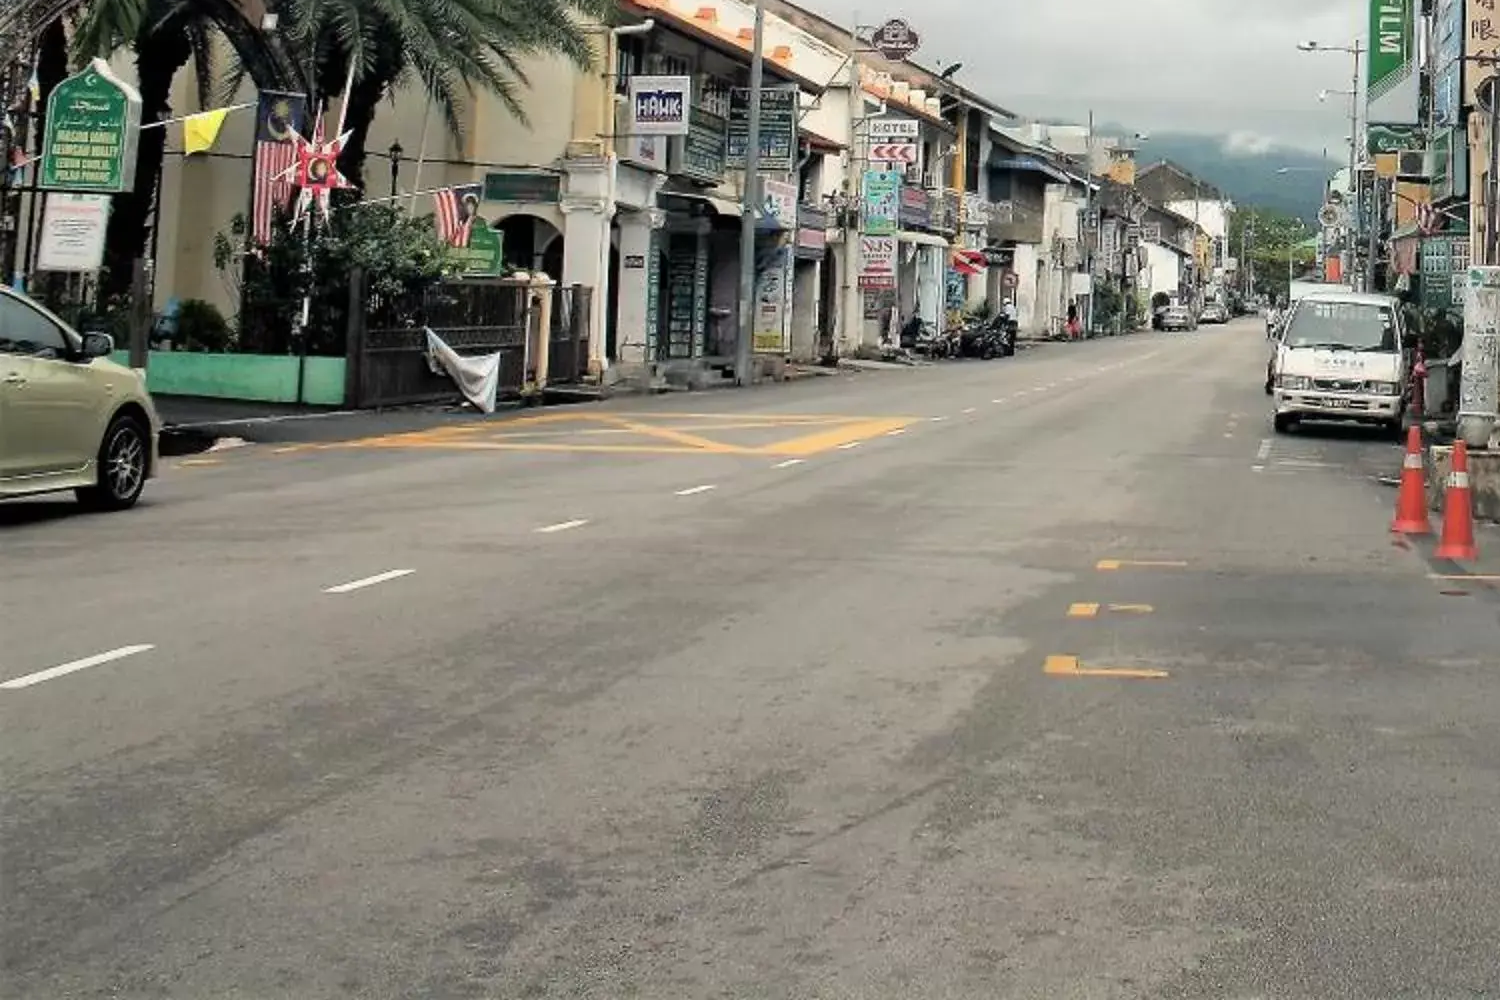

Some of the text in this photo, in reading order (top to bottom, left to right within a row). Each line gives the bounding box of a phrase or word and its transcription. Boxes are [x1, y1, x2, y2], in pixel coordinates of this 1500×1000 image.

[636, 95, 681, 116] HAWK
[873, 122, 916, 133] HOTEL
[863, 239, 893, 253] NJS
